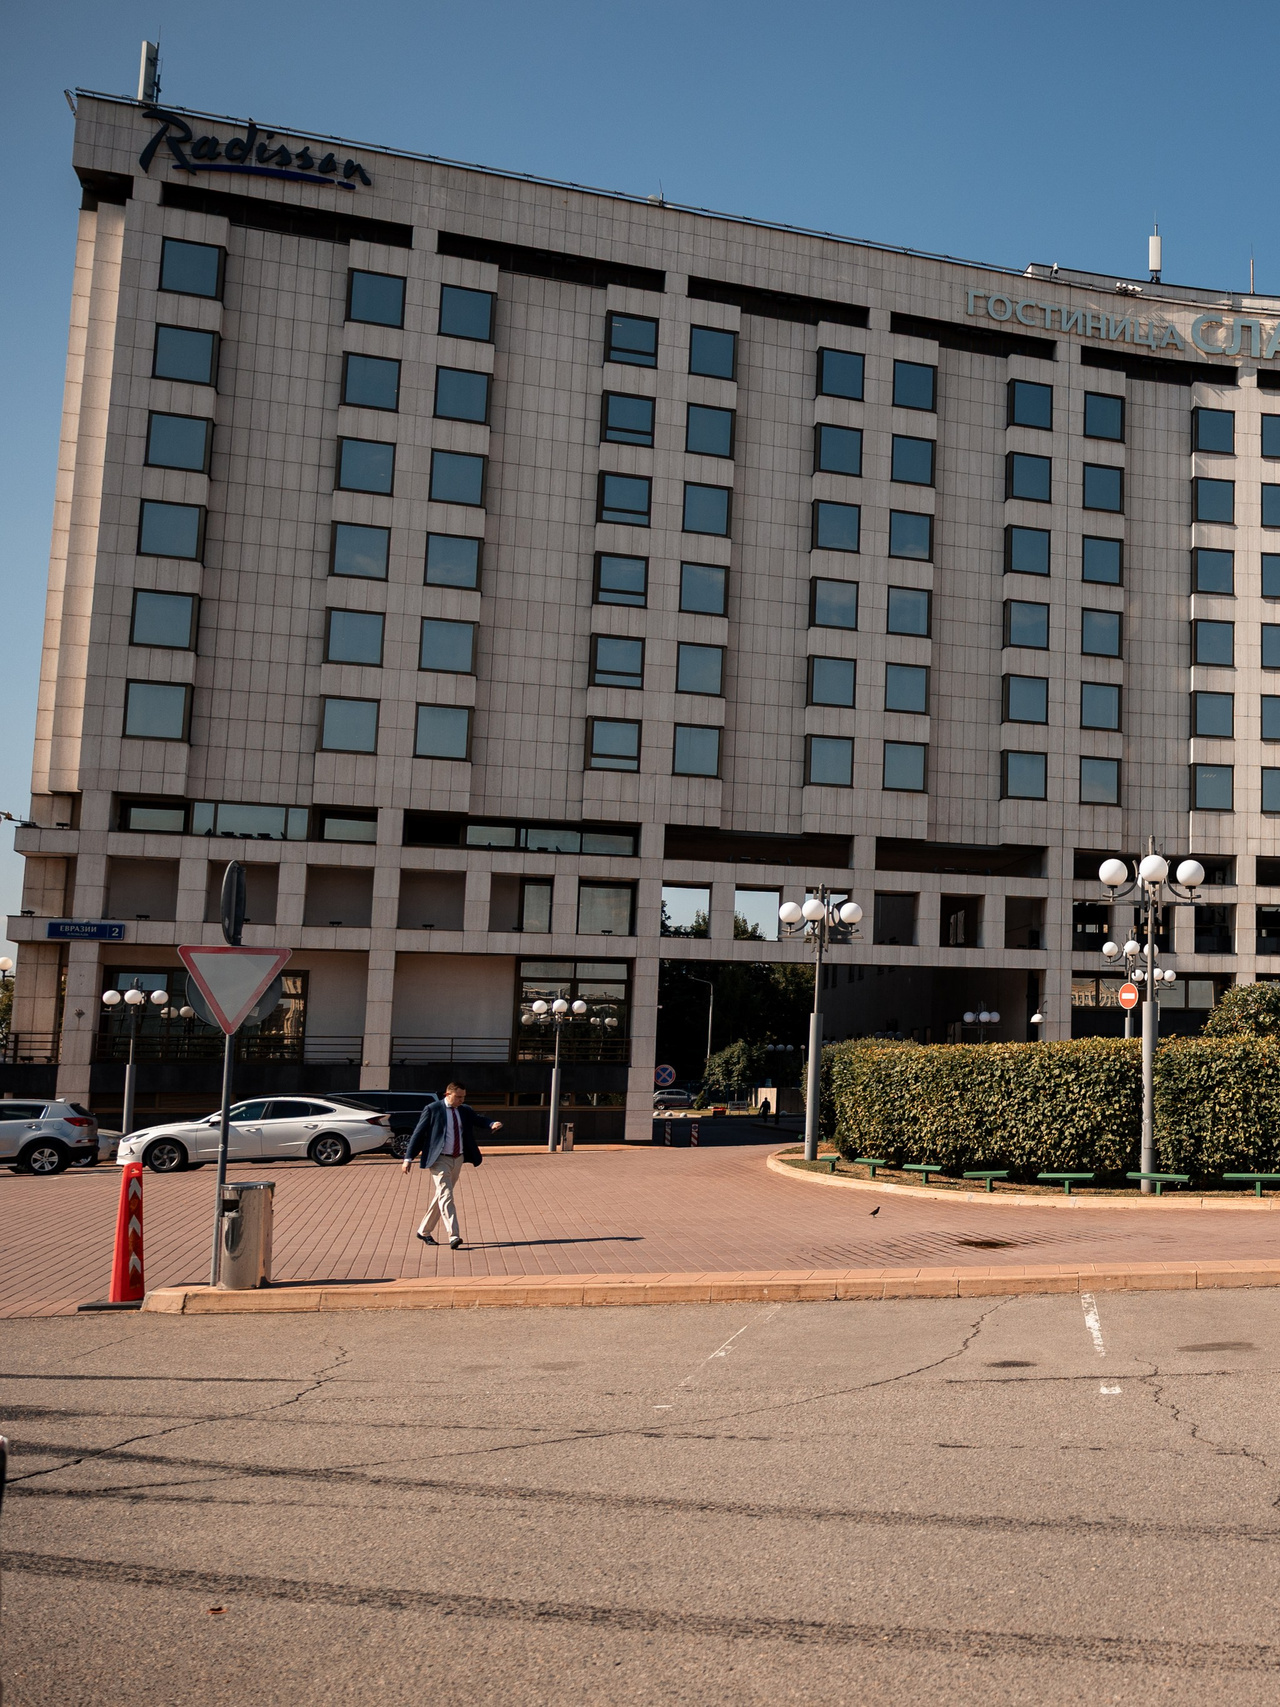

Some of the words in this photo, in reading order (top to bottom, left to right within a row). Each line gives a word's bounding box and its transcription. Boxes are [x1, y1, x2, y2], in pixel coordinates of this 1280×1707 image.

[138, 109, 372, 187] Radisson
[965, 289, 1185, 351] ГОСТИНИЦА
[59, 925, 97, 933] ЕВРАЗИИ
[112, 927, 120, 937] 2
